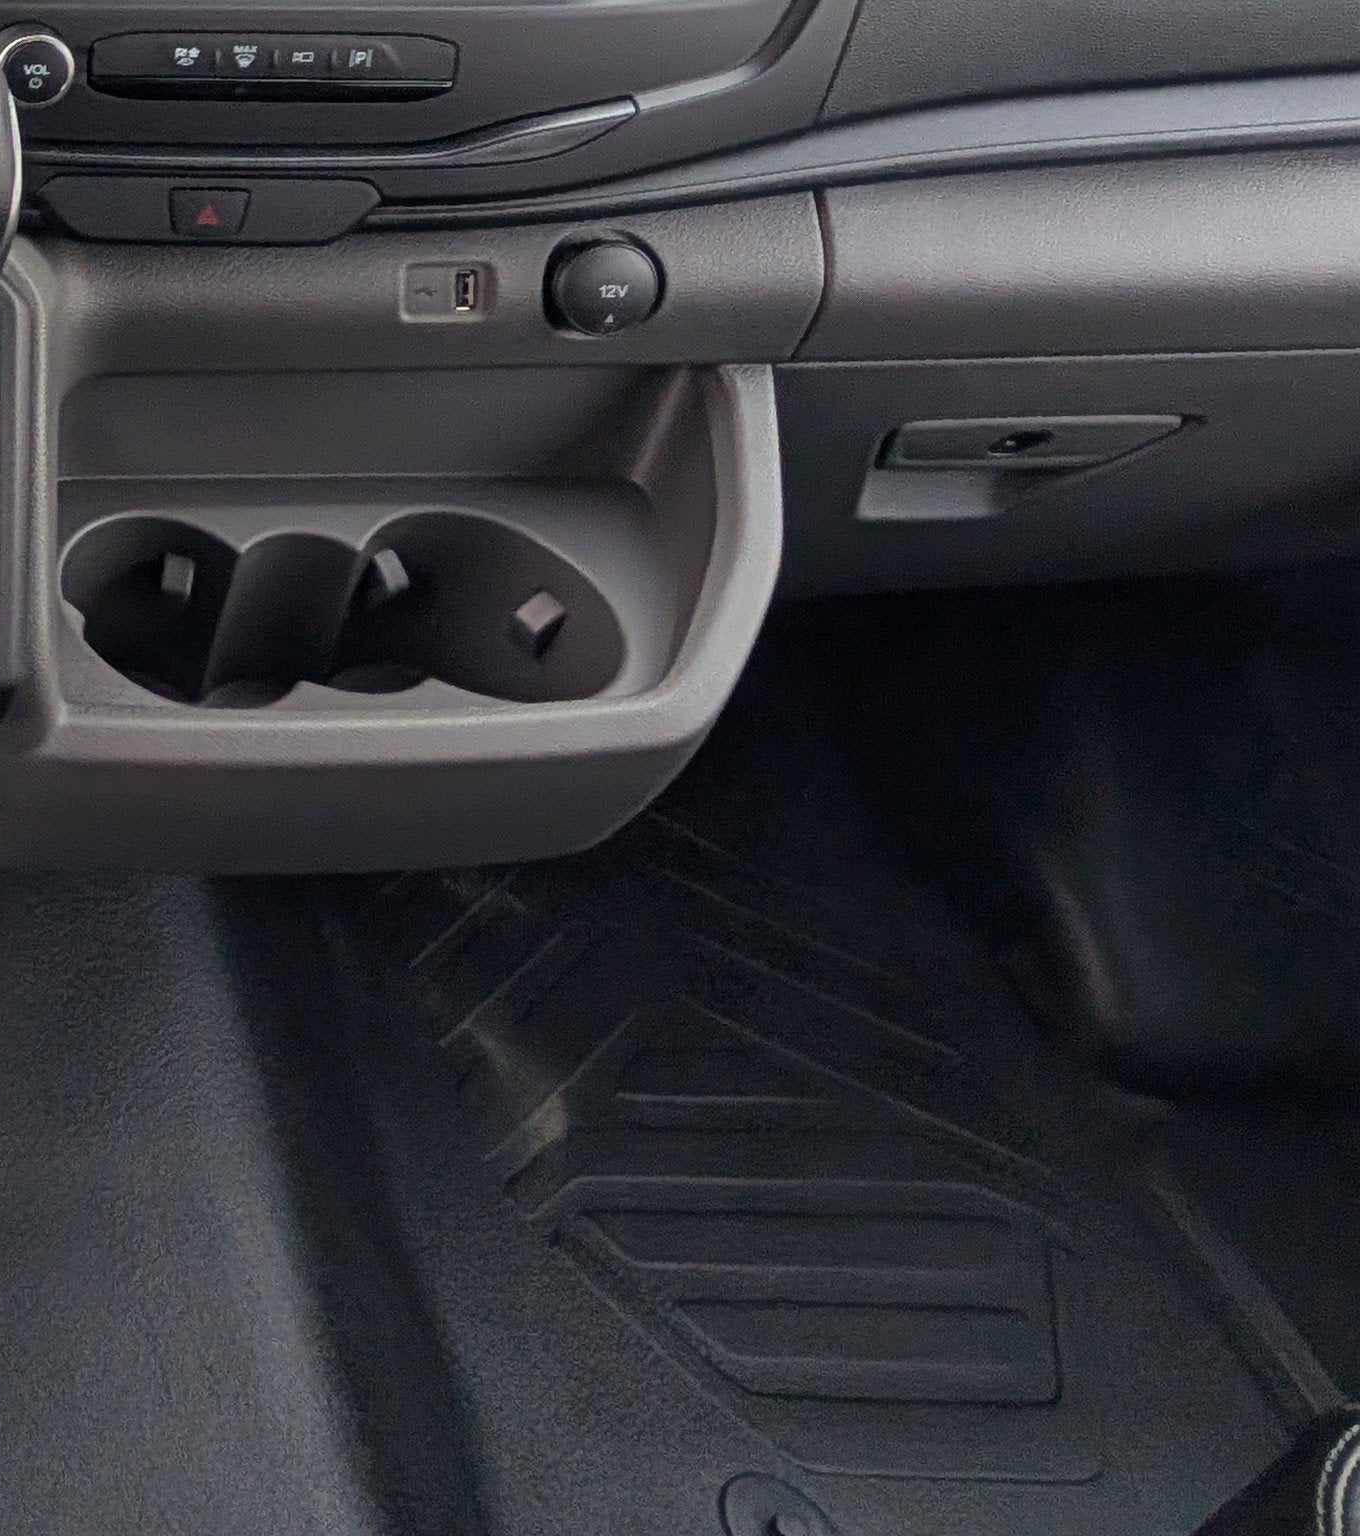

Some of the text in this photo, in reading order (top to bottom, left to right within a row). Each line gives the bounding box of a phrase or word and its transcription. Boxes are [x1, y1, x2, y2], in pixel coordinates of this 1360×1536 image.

[232, 44, 259, 54] MAX
[22, 63, 52, 76] VOL
[597, 283, 630, 300] 12V
